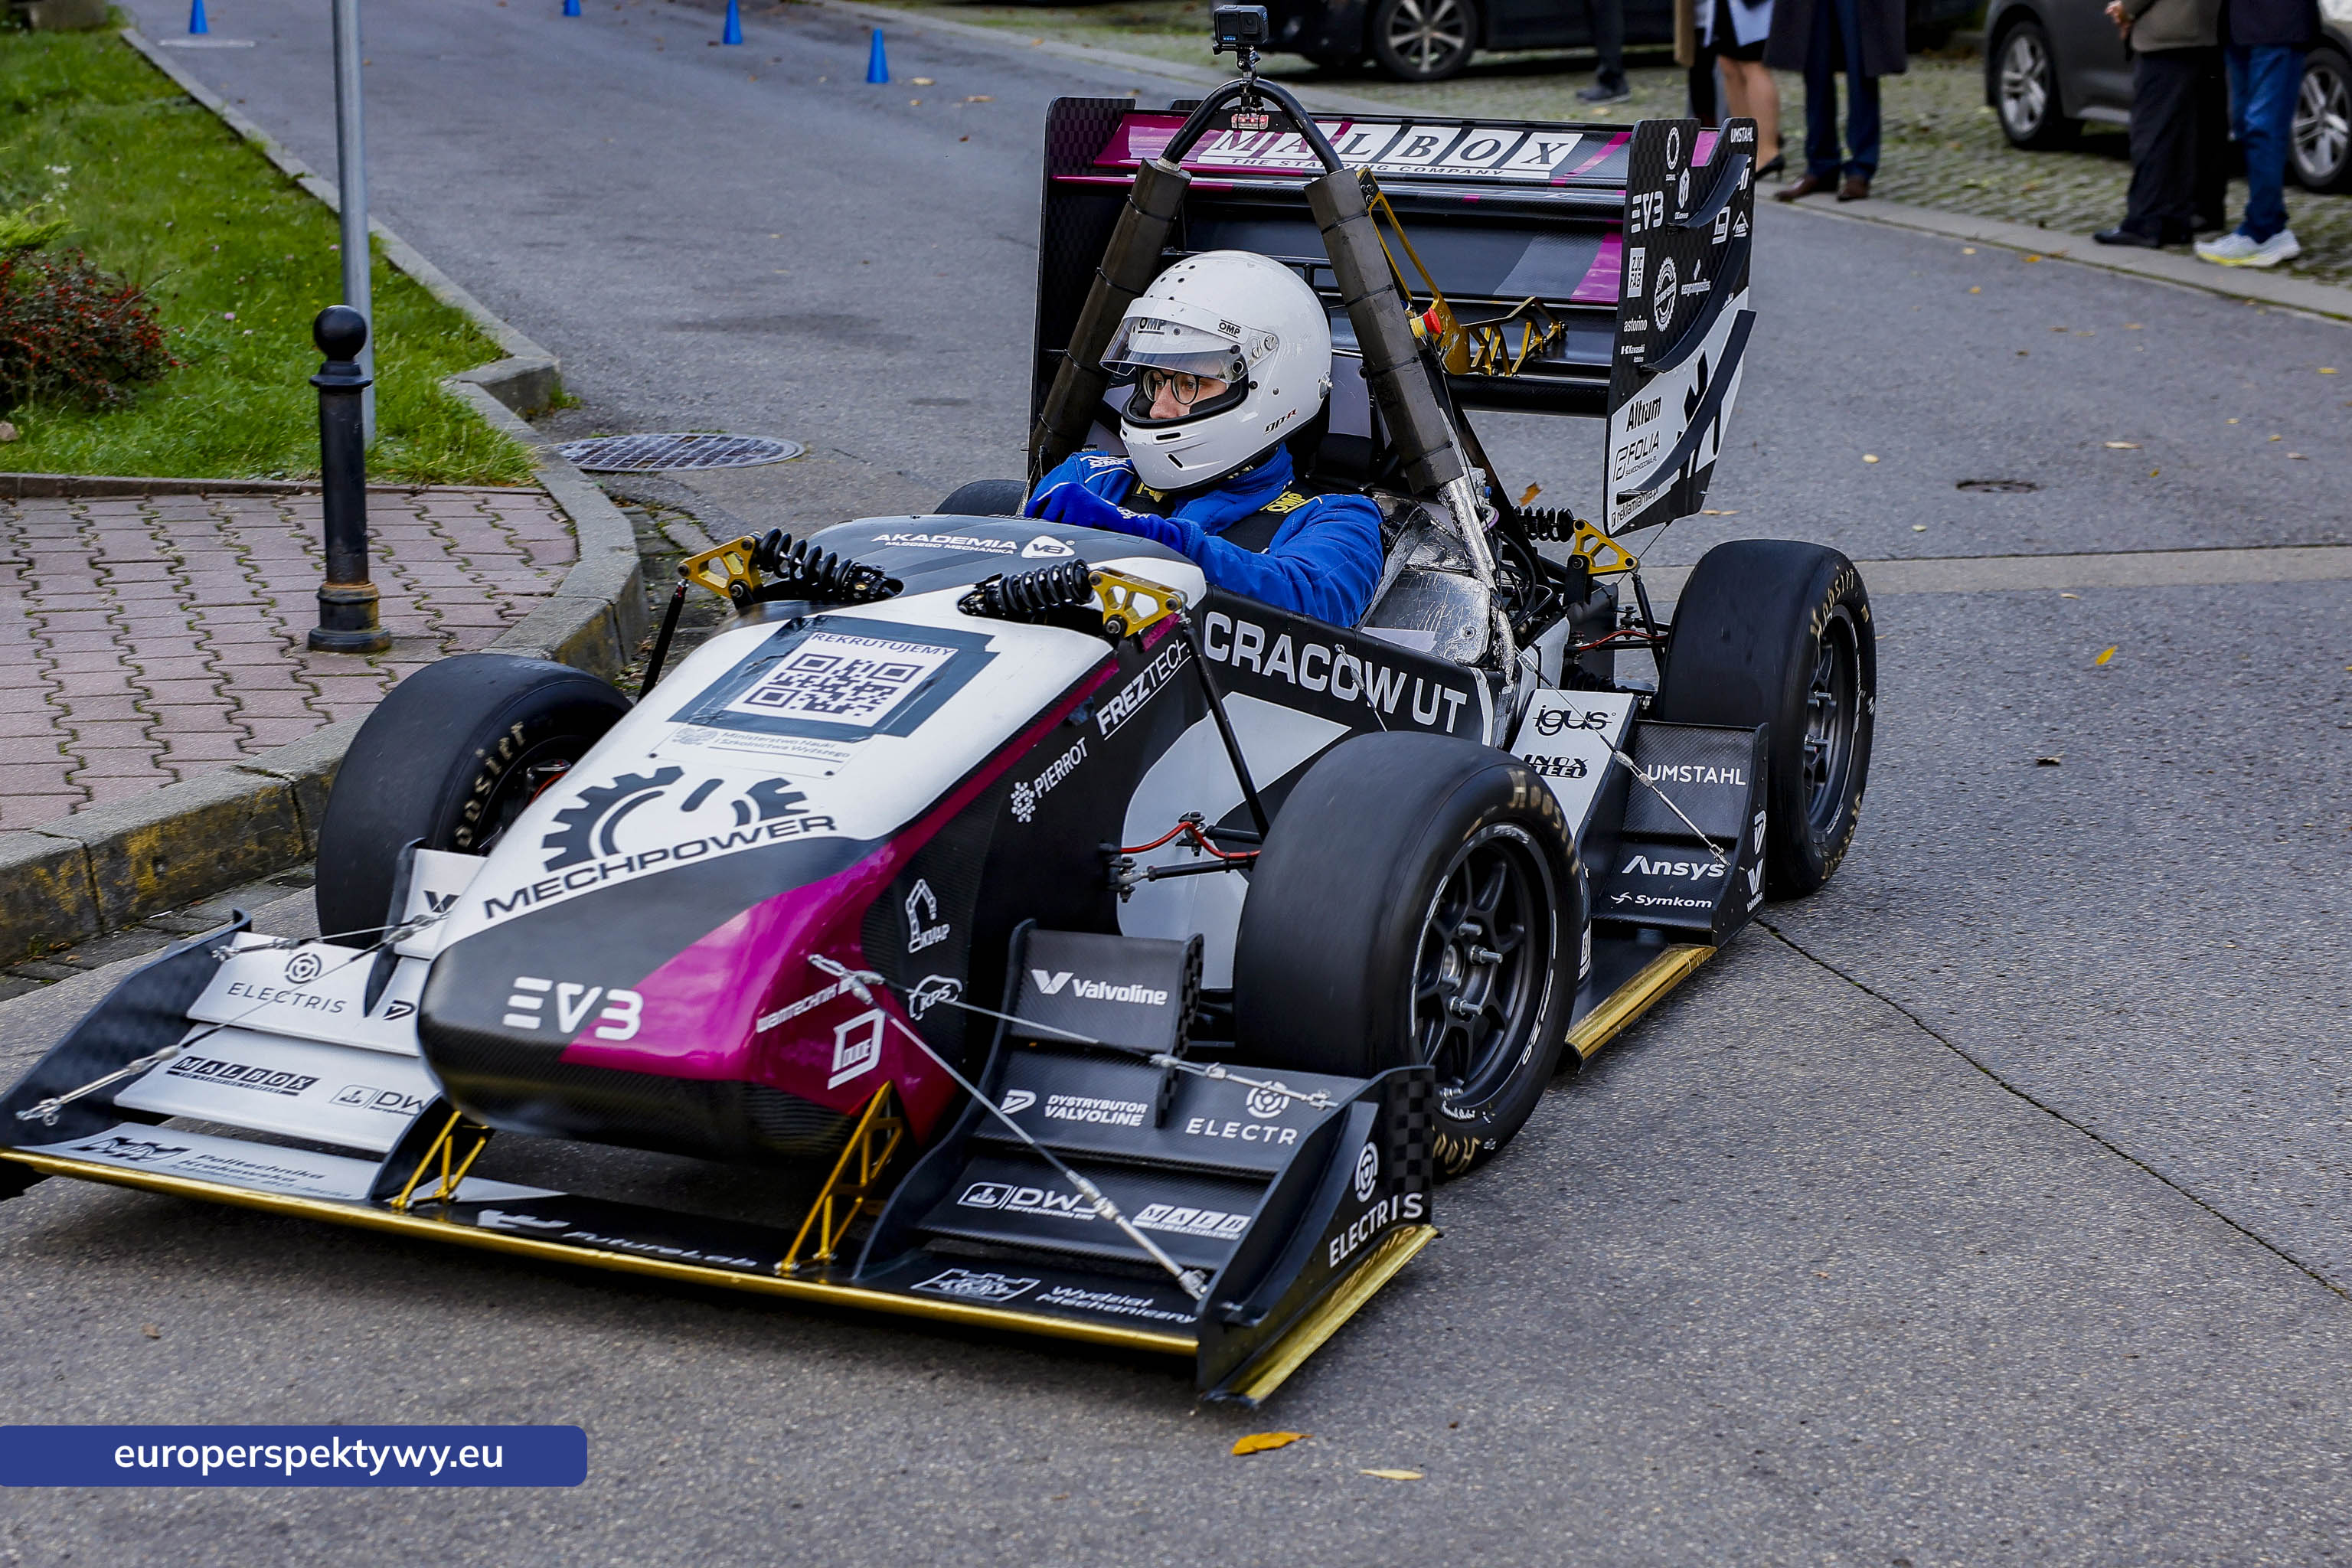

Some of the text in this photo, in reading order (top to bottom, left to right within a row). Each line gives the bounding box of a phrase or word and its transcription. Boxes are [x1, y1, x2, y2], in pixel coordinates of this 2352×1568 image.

[1211, 128, 1569, 165] MALBOX
[1275, 158, 1389, 172] STAPING
[1398, 164, 1506, 176] COMPANY
[1218, 322, 1242, 337] OMP
[1623, 315, 1648, 333] astorino
[1627, 430, 1660, 466] FOLIA
[1266, 493, 1306, 512] OMP
[870, 534, 1018, 550] AKADEMIA
[812, 632, 956, 657] REKRUTUJEMY
[1204, 611, 1468, 734] CRACOW UT
[1034, 737, 1089, 800] PIERROT
[1531, 765, 1588, 779] TEEL
[1646, 764, 1747, 786] UMSTAHL
[483, 815, 838, 920] MECHPOWER
[1621, 854, 1726, 881] Ansys
[1635, 894, 1713, 909] Symkom
[227, 982, 348, 1014] ELECTRIS
[1072, 978, 1169, 1006] Valvoline
[173, 1057, 315, 1090] MALBOX
[374, 1091, 424, 1114] DW
[1047, 1094, 1149, 1114] DYSTRYBUTOR
[1043, 1106, 1145, 1128] VALVOLINE
[1185, 1117, 1298, 1145] ELECTR
[1139, 1207, 1248, 1230] MALB
[1328, 1191, 1424, 1269] ELECTRIS
